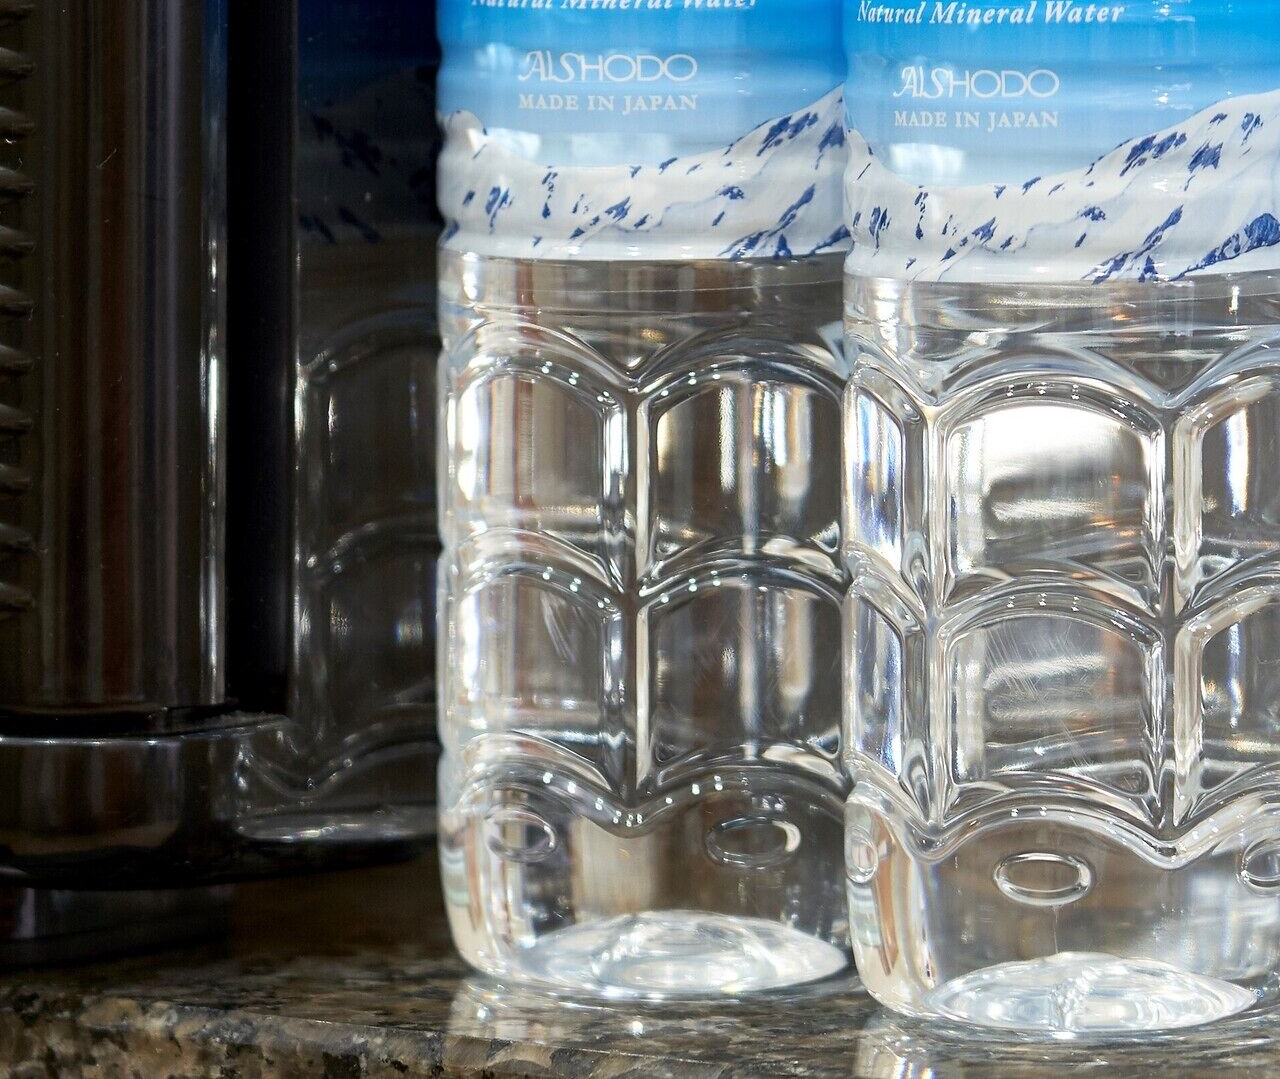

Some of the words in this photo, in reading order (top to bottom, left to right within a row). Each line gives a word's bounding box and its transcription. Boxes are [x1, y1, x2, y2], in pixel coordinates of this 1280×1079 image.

[856, 0, 926, 25] Natural
[928, 0, 1039, 25] Mineral
[1043, 0, 1126, 24] Water
[518, 93, 579, 111] MADE
[587, 95, 615, 111] IN
[622, 93, 698, 116] JAPAN
[894, 110, 947, 128] MADE
[955, 111, 981, 128] IN
[987, 110, 1059, 133] JAPAN
